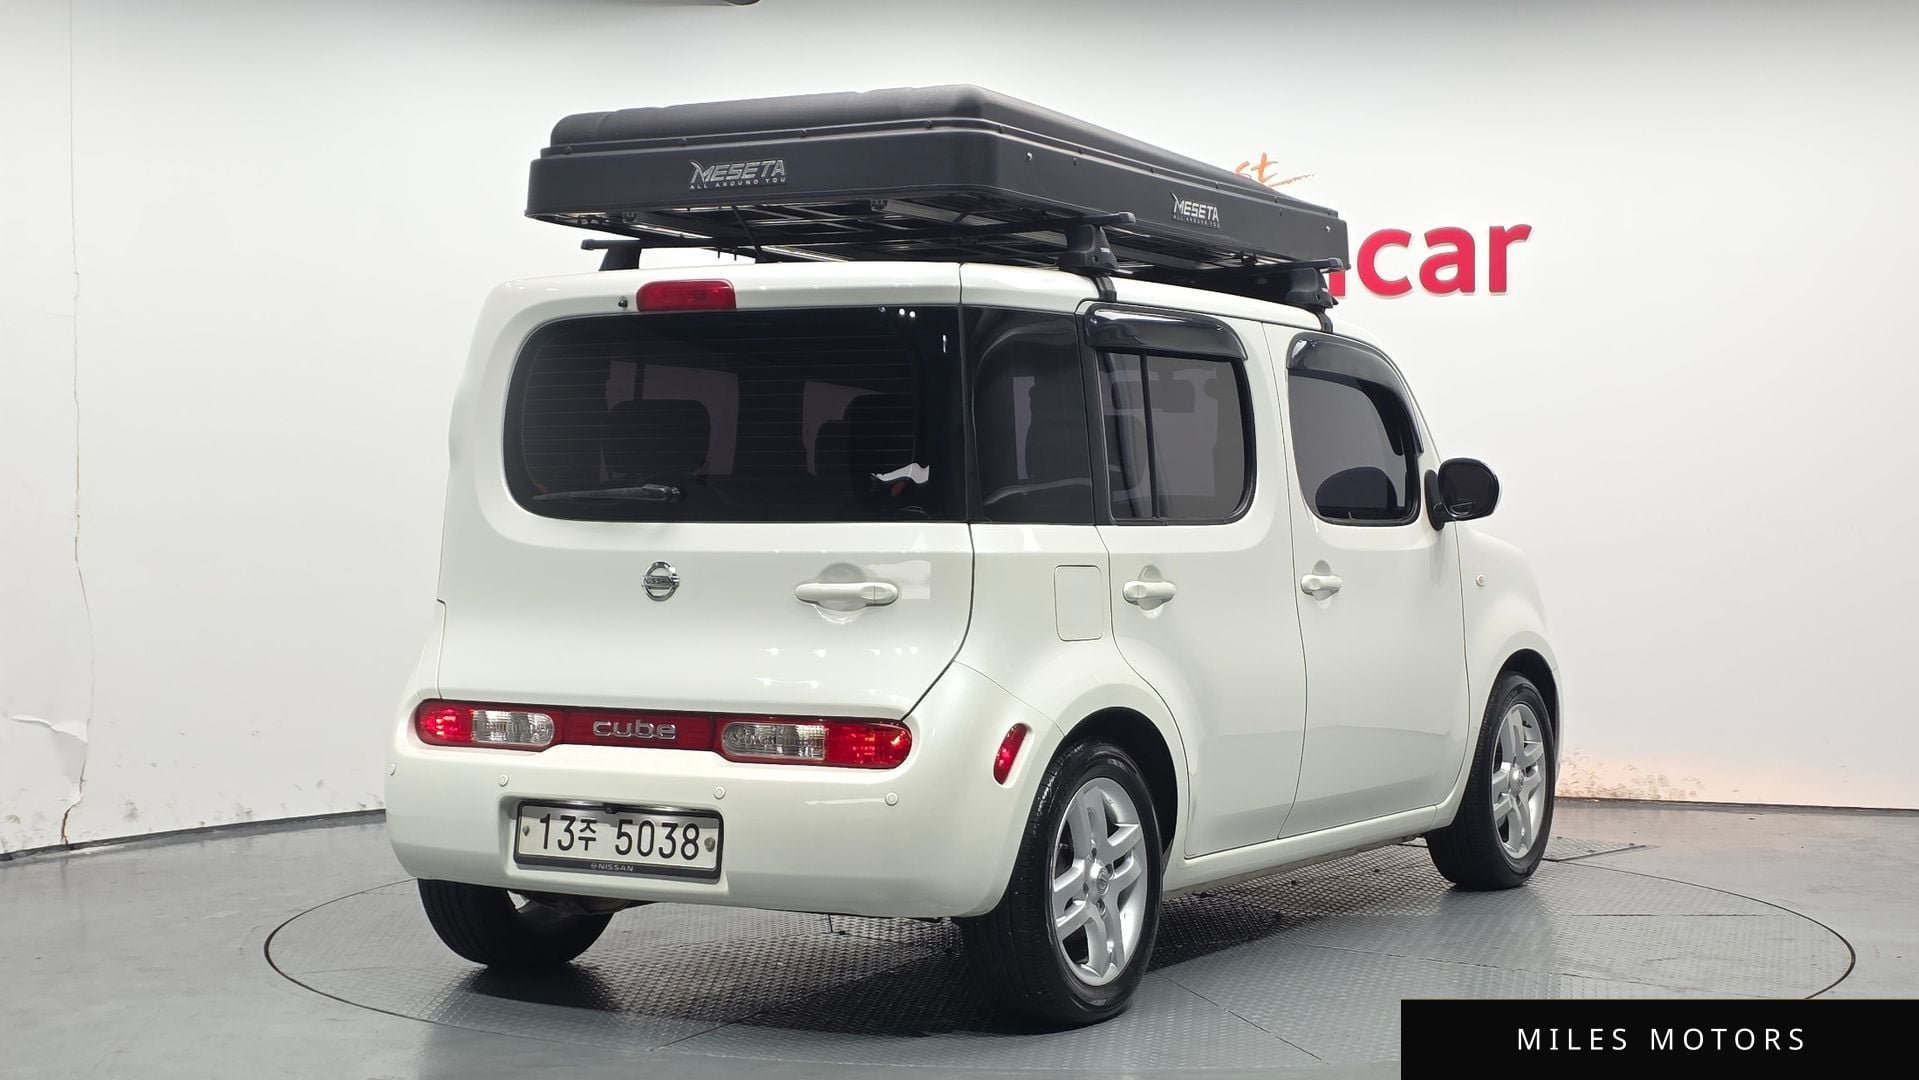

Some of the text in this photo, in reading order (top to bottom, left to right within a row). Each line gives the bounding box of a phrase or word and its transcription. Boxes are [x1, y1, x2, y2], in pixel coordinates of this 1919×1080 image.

[690, 160, 785, 184] MESETA
[715, 179, 759, 188] AROUND
[1171, 192, 1219, 221] MESETA
[593, 720, 676, 739] cube
[539, 813, 700, 861] 13주 5038
[597, 863, 634, 872] NISSAN
